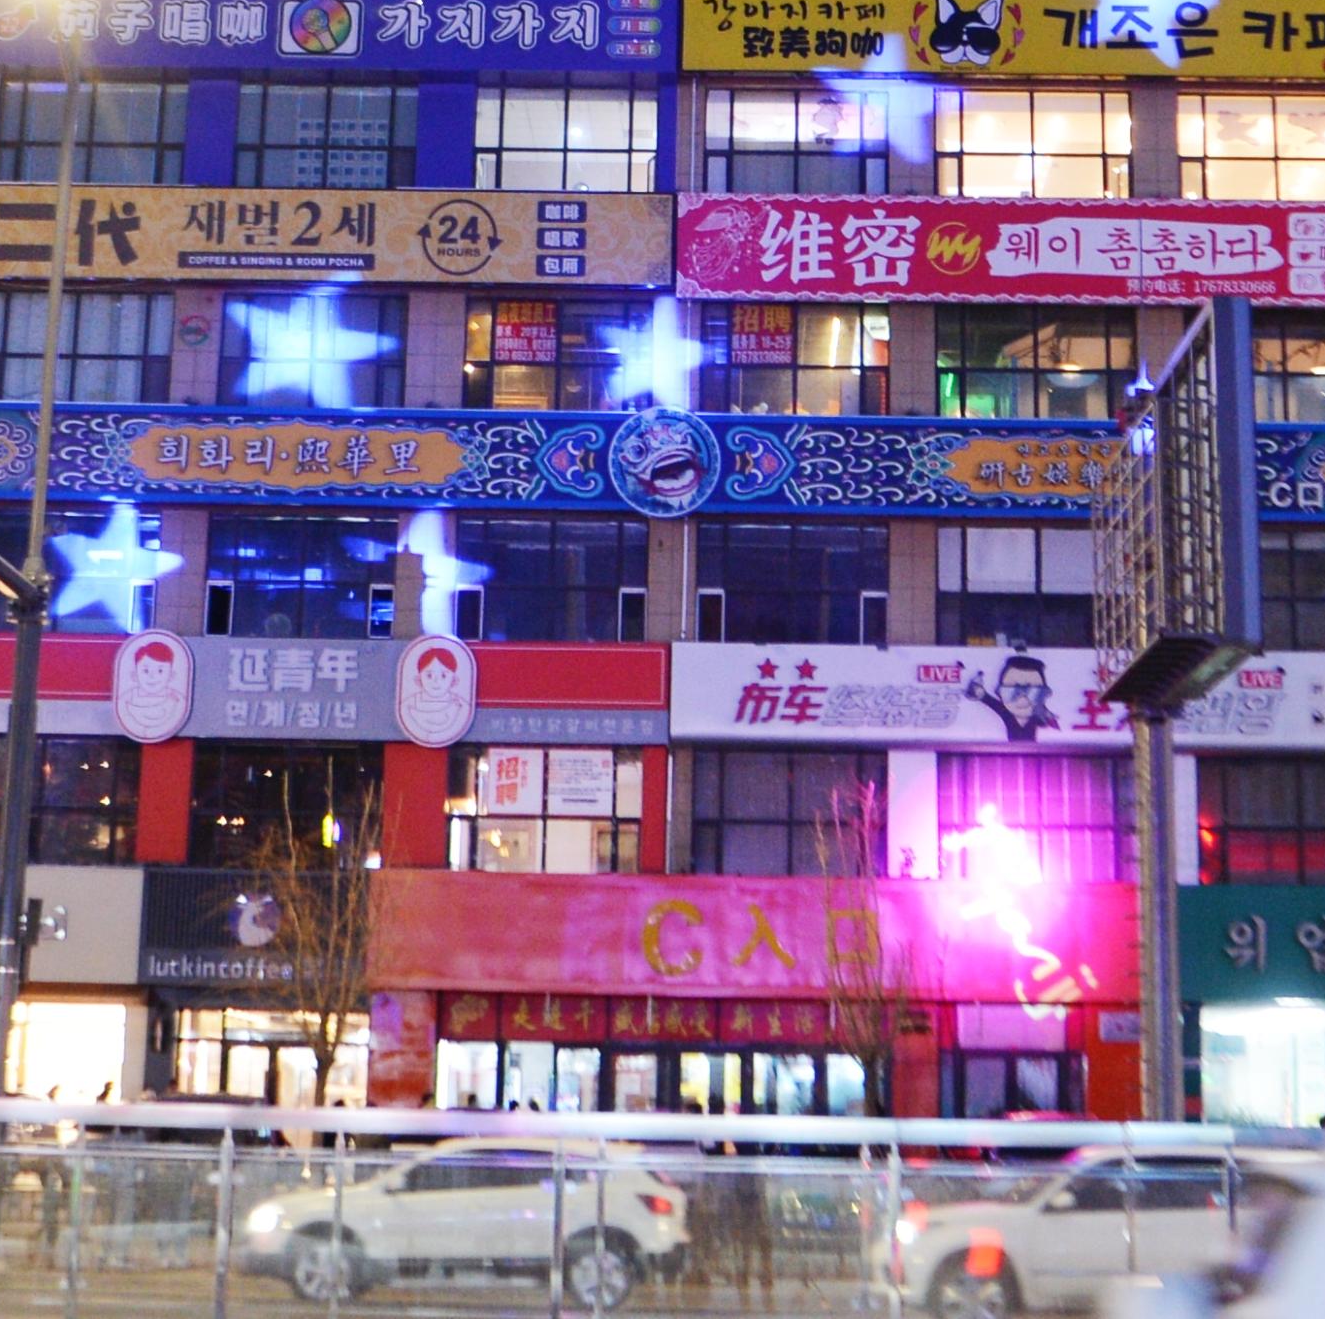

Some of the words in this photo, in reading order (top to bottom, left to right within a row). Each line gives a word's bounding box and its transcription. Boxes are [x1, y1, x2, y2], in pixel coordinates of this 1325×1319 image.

[377, 0, 601, 51] 가지가지
[182, 199, 377, 249] 재벌2세
[437, 215, 482, 245] 24
[436, 247, 482, 258] HOURS
[758, 207, 923, 288] 维密
[732, 304, 794, 333] 招聘
[226, 647, 359, 690] 延青年
[918, 665, 960, 682] LIVE
[641, 899, 703, 977] C
[733, 903, 876, 970] 入口
